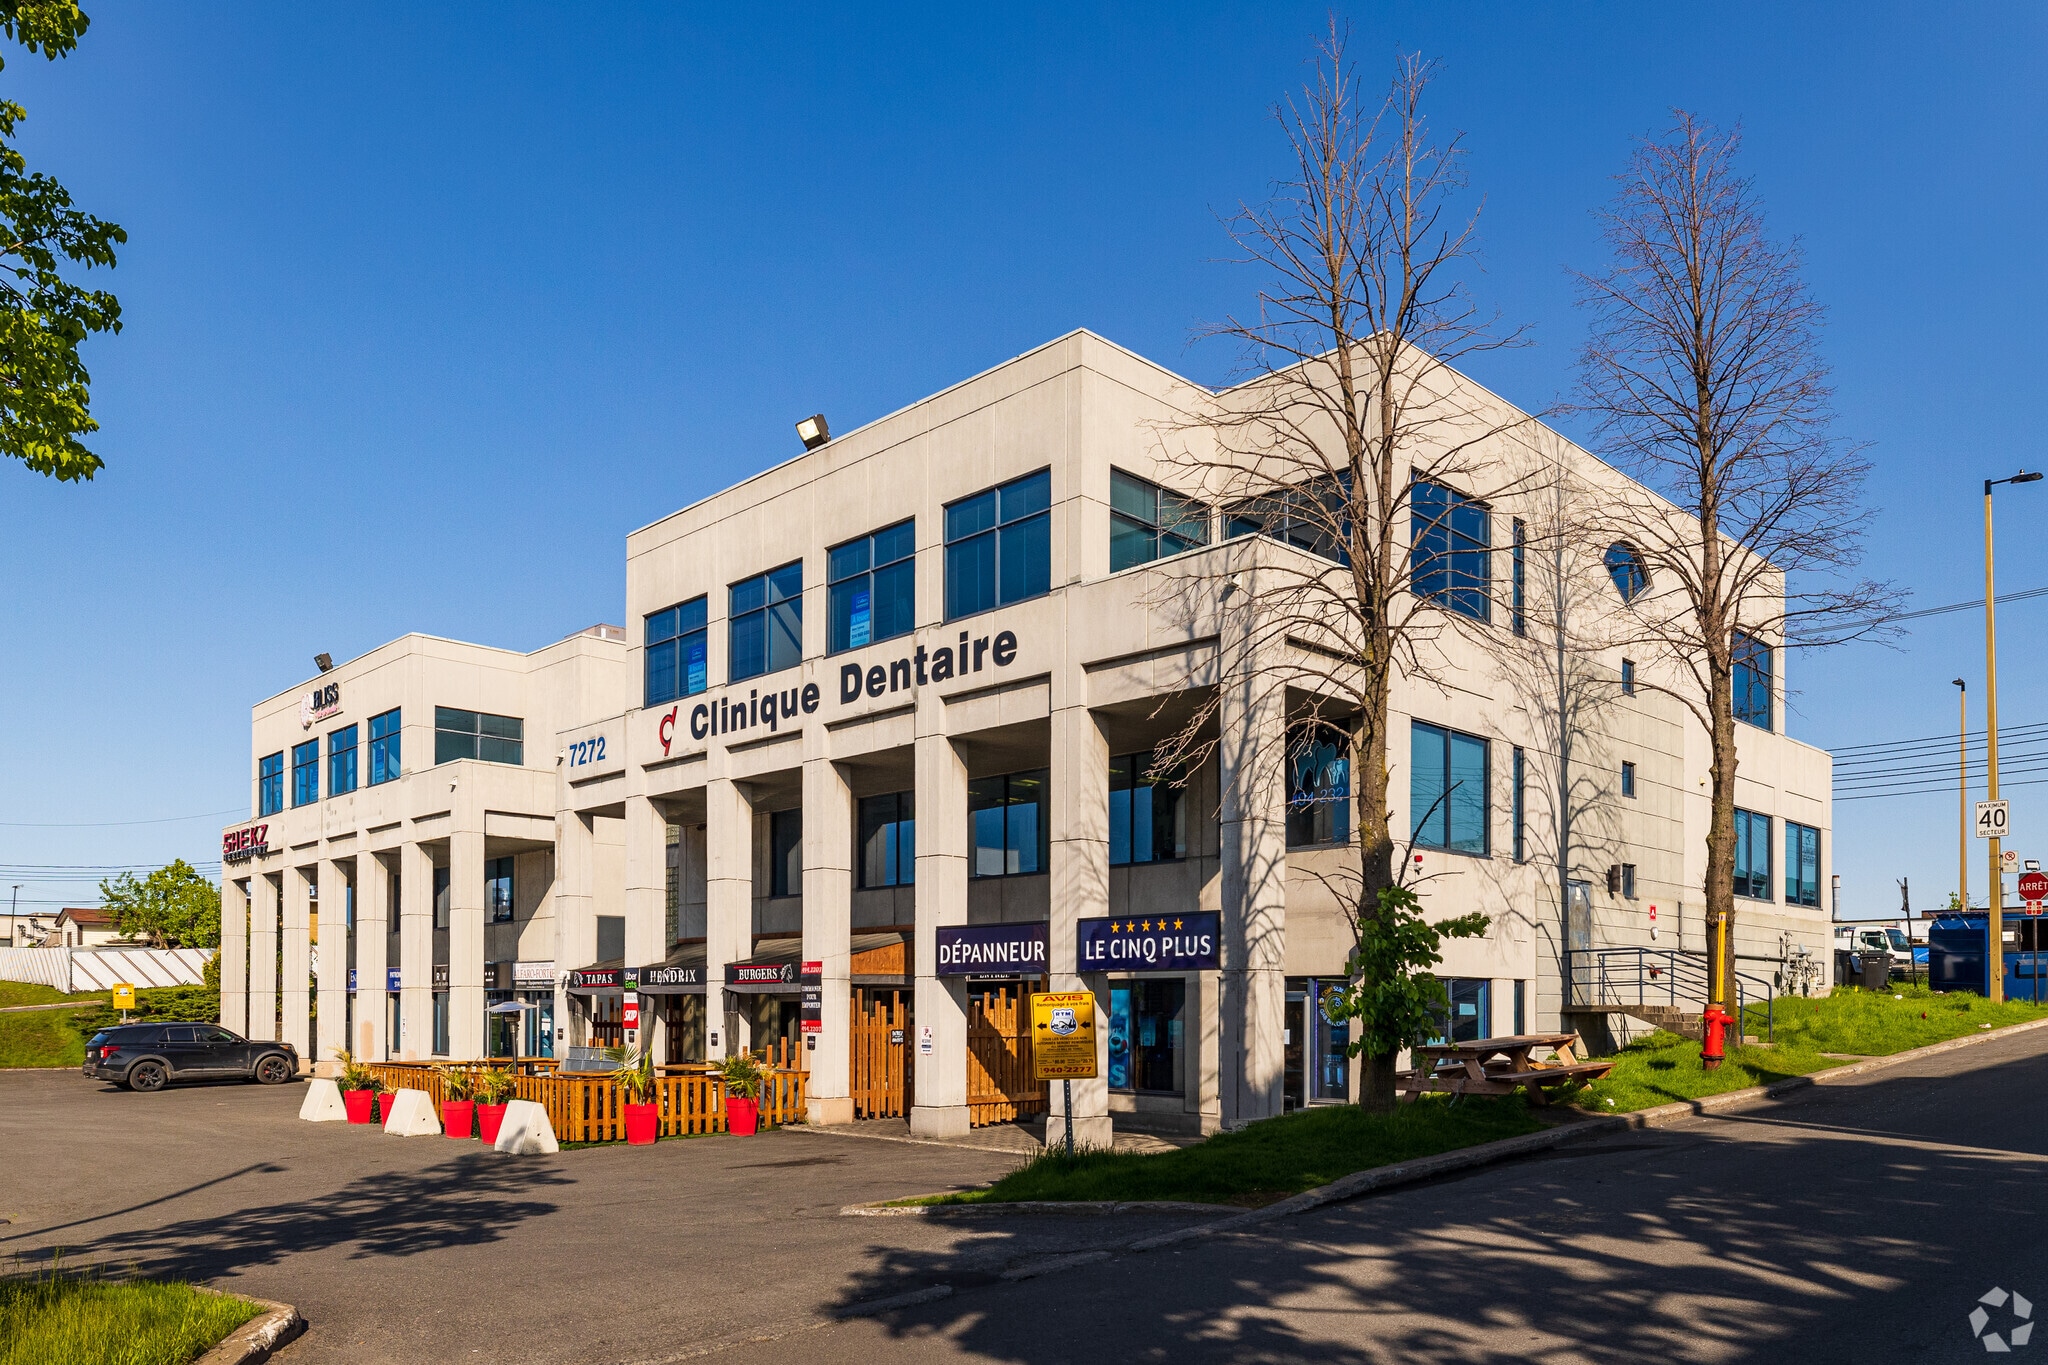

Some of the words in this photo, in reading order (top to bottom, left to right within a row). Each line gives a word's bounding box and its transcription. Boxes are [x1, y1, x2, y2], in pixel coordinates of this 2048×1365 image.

[690, 682, 820, 741] Clinique
[840, 630, 1018, 705] Dentaire
[313, 682, 339, 709] BLISS
[569, 736, 606, 767] 7272
[1979, 808, 2006, 828] 40
[223, 824, 269, 854] SHEKZ
[223, 844, 269, 862] RESTAURANT
[2020, 880, 2048, 891] ARRÊT
[939, 938, 1046, 964] DÉPANNEUR
[1085, 939, 1106, 960] LE
[1109, 937, 1157, 963] CINQ
[1162, 935, 1212, 957] PLUS
[586, 974, 613, 984] TAPAS
[625, 972, 637, 980] Uber
[650, 968, 696, 984] HENDRIX
[738, 967, 778, 980] BURGERS
[624, 981, 637, 989] Eats
[801, 1001, 821, 1009] EMPORTER
[1042, 994, 1084, 1002] AVIS
[624, 1009, 638, 1022] SKIP
